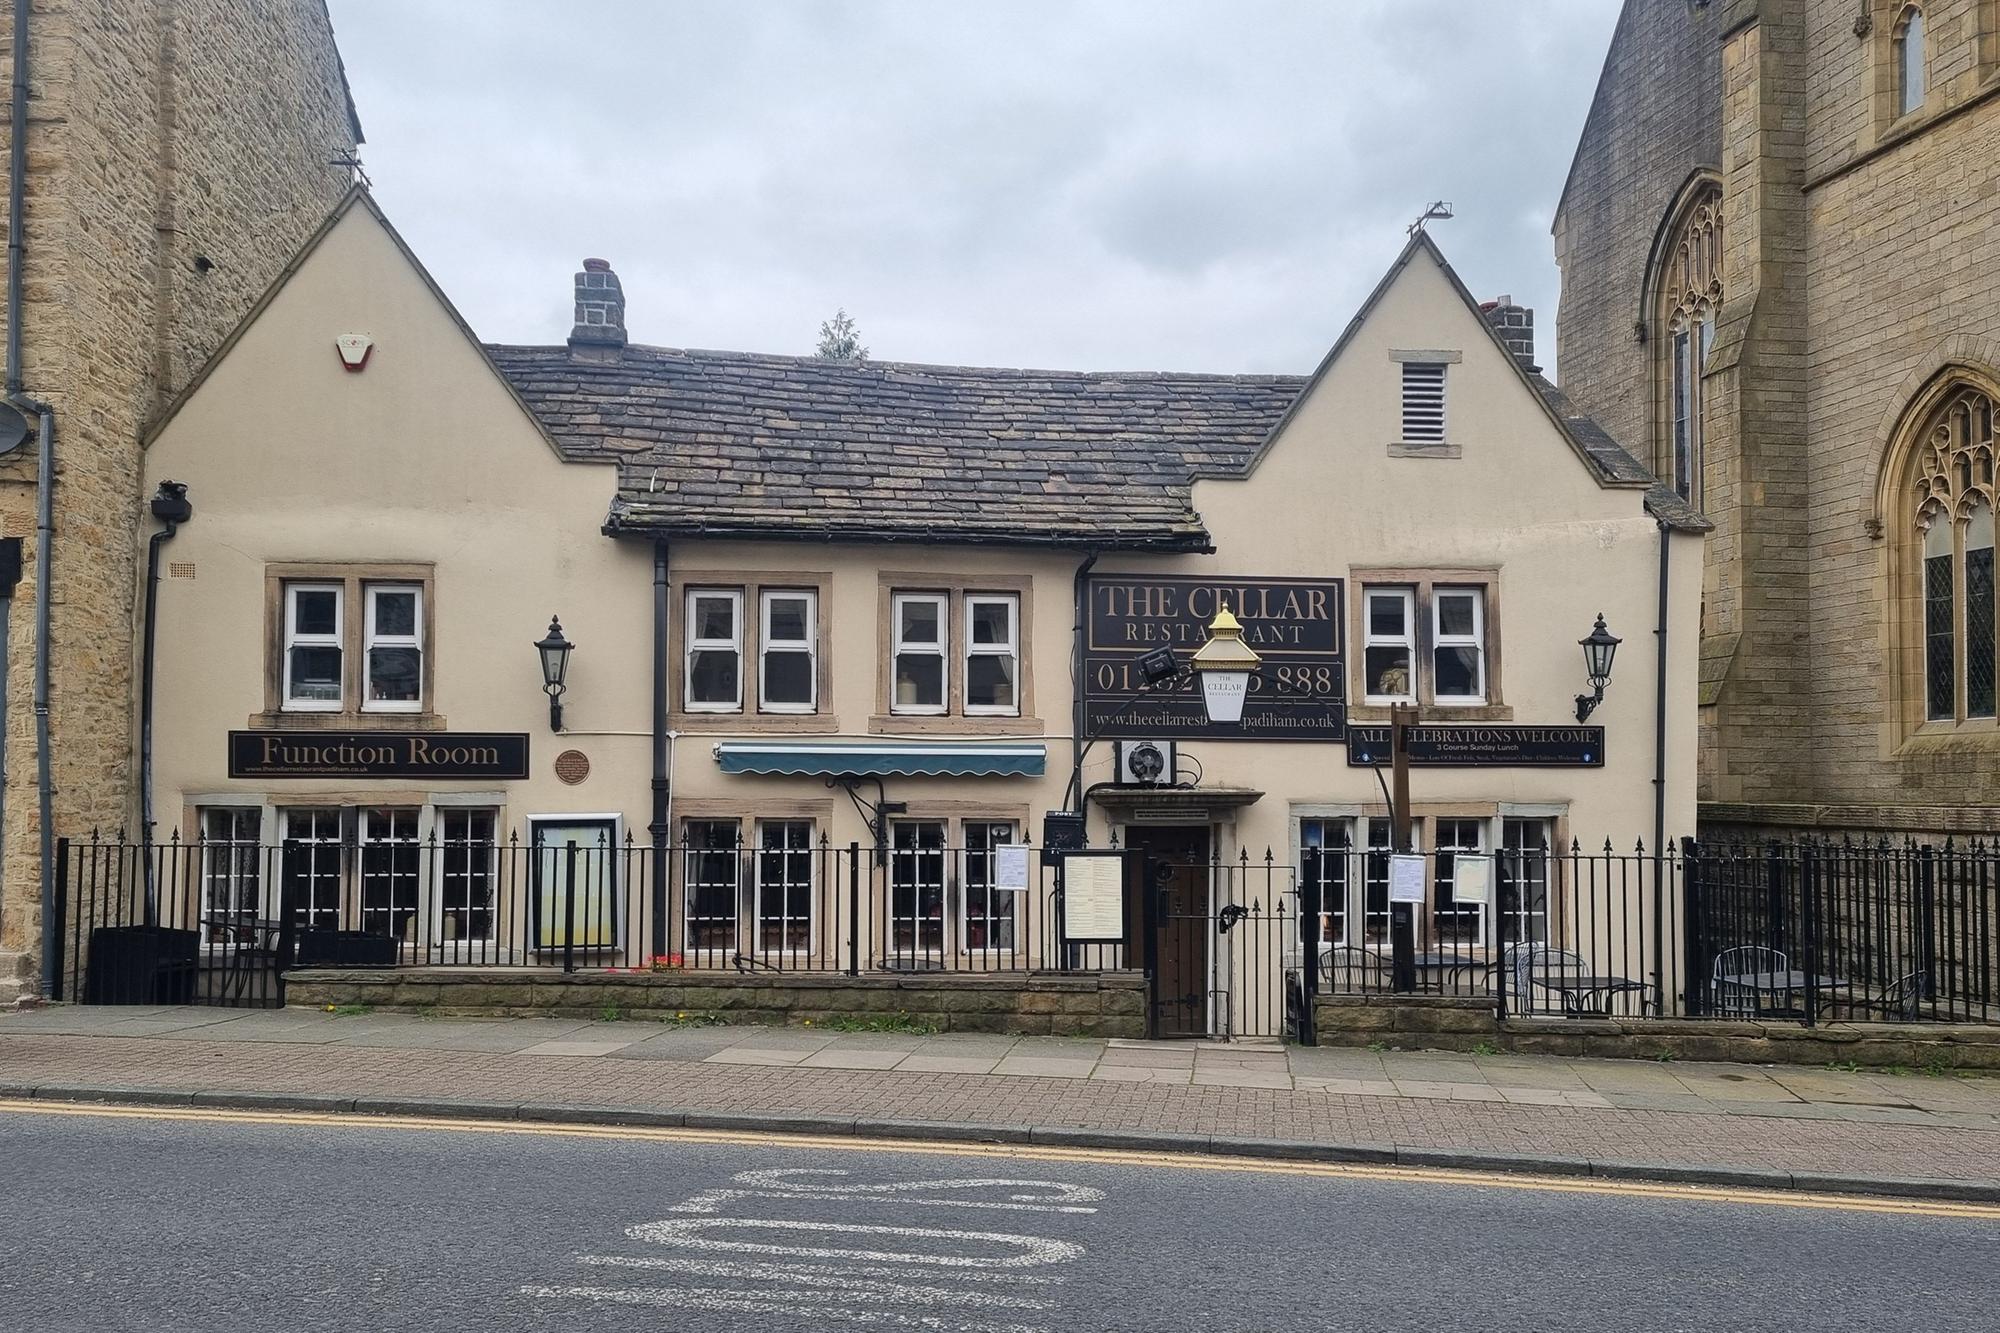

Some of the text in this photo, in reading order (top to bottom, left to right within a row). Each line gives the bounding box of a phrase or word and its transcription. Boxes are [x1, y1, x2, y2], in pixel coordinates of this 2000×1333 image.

[1099, 585, 1329, 621] THE CELLAR
[1126, 623, 1304, 644] RESTARANT
[1207, 682, 1242, 692] CELLAR
[1359, 730, 1595, 743] ALL ELEBRATIONS WELCOME
[262, 736, 499, 765] Function Room
[1469, 743, 1495, 752] Sunday
[520, 1167, 1106, 1333] SLOW
